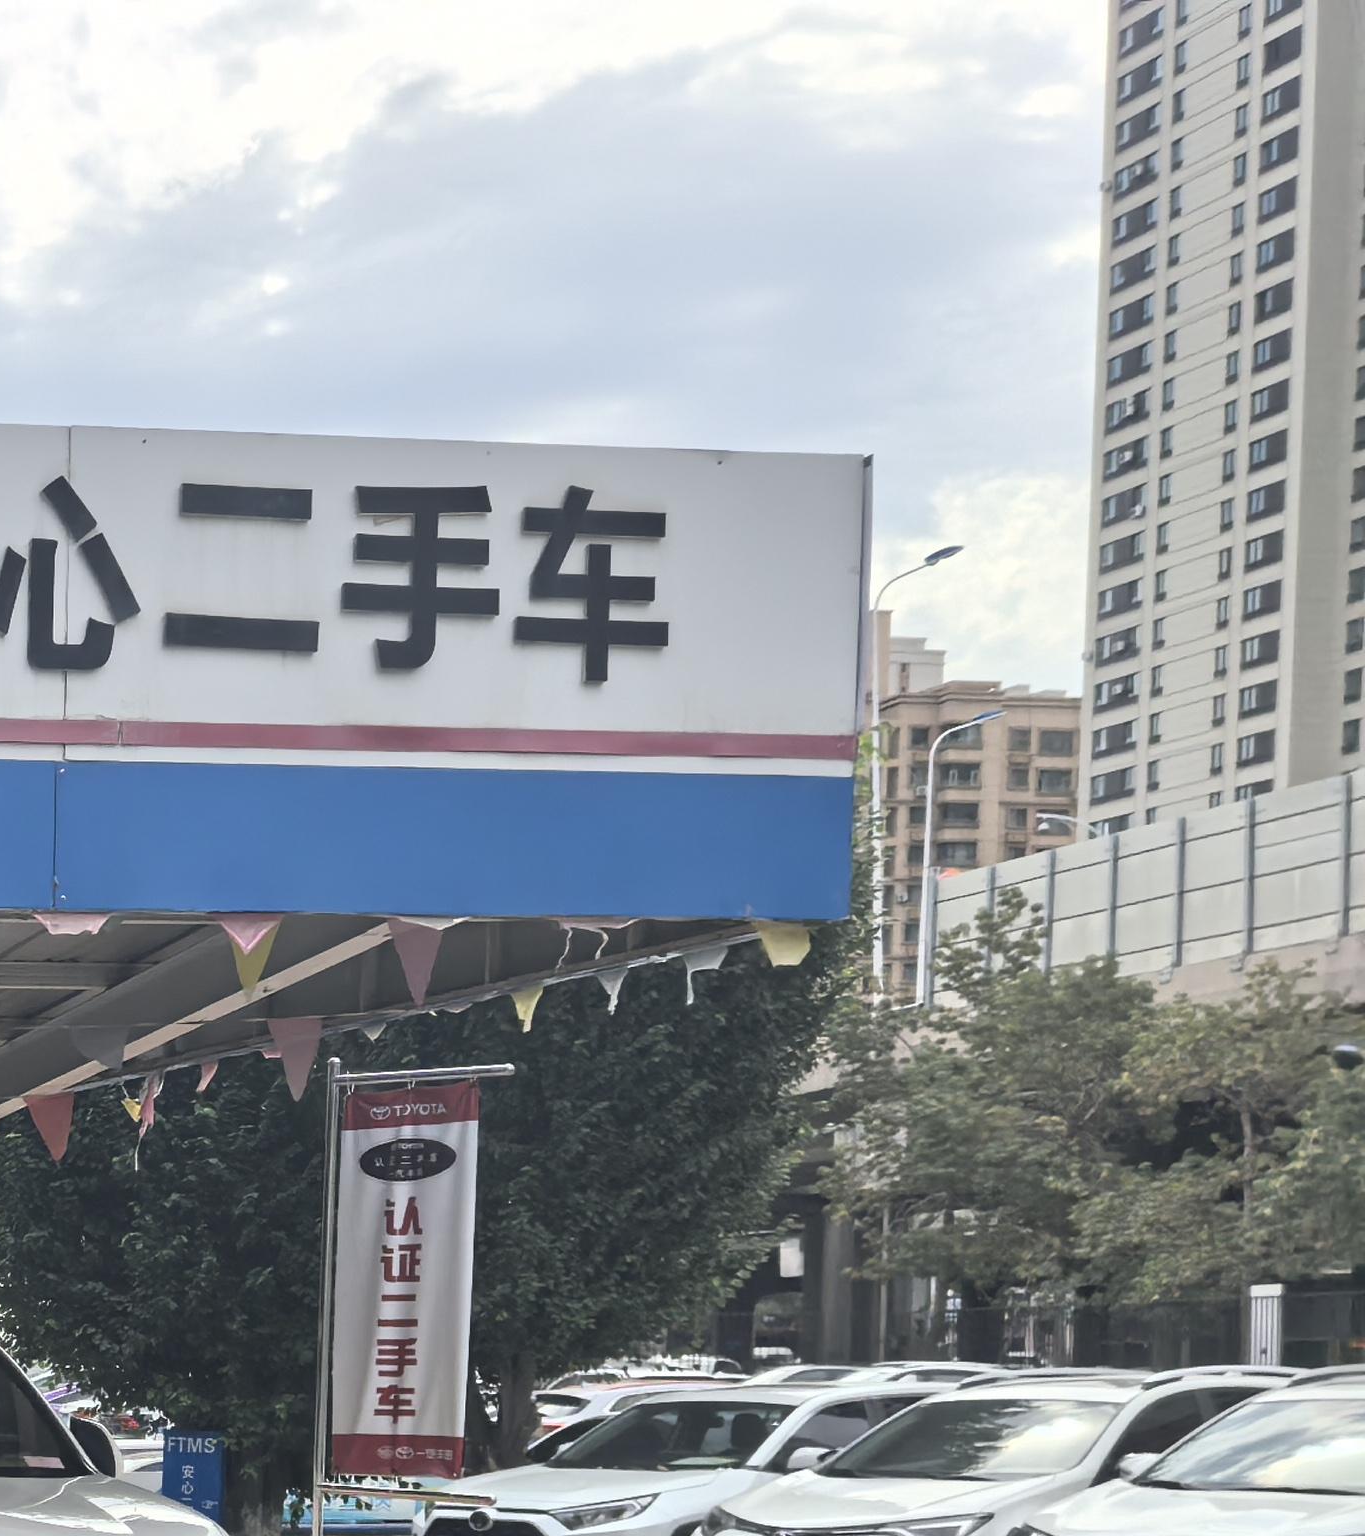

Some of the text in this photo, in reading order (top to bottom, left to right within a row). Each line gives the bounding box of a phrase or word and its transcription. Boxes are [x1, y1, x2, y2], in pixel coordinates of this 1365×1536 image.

[373, 1196, 424, 1425] 认证二手车
[167, 1436, 216, 1453] FTMS
